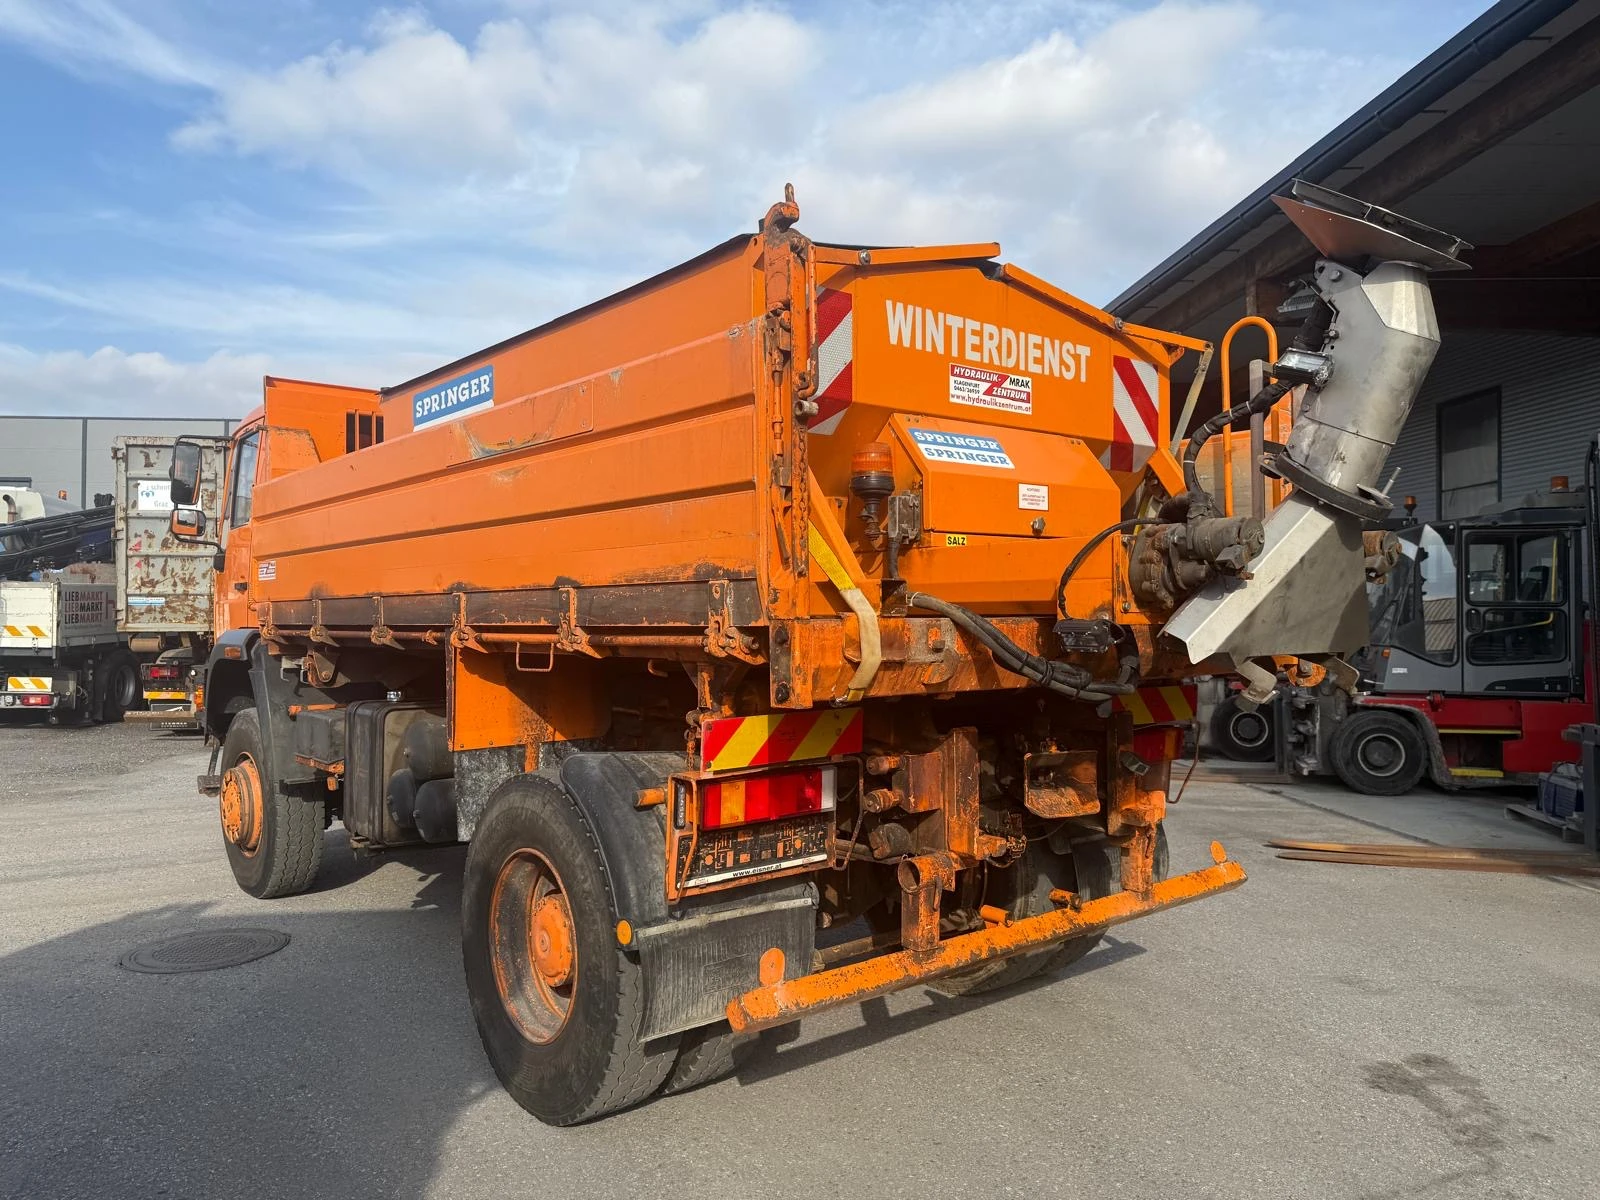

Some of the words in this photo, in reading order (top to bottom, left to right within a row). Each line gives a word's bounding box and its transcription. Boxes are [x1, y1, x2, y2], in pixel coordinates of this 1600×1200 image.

[885, 299, 1091, 383] WINTERDIENST
[953, 366, 1002, 382] HYDRAULIK-
[1008, 377, 1030, 389] MRAK
[992, 387, 1027, 400] ZENTRUM
[951, 393, 1031, 412] www.hydraulikzentrum.at
[913, 431, 1000, 450] SPRINGER
[924, 447, 1010, 465] SPRINGER
[947, 536, 966, 546] SALZ
[732, 863, 782, 878] www.eisner.at
